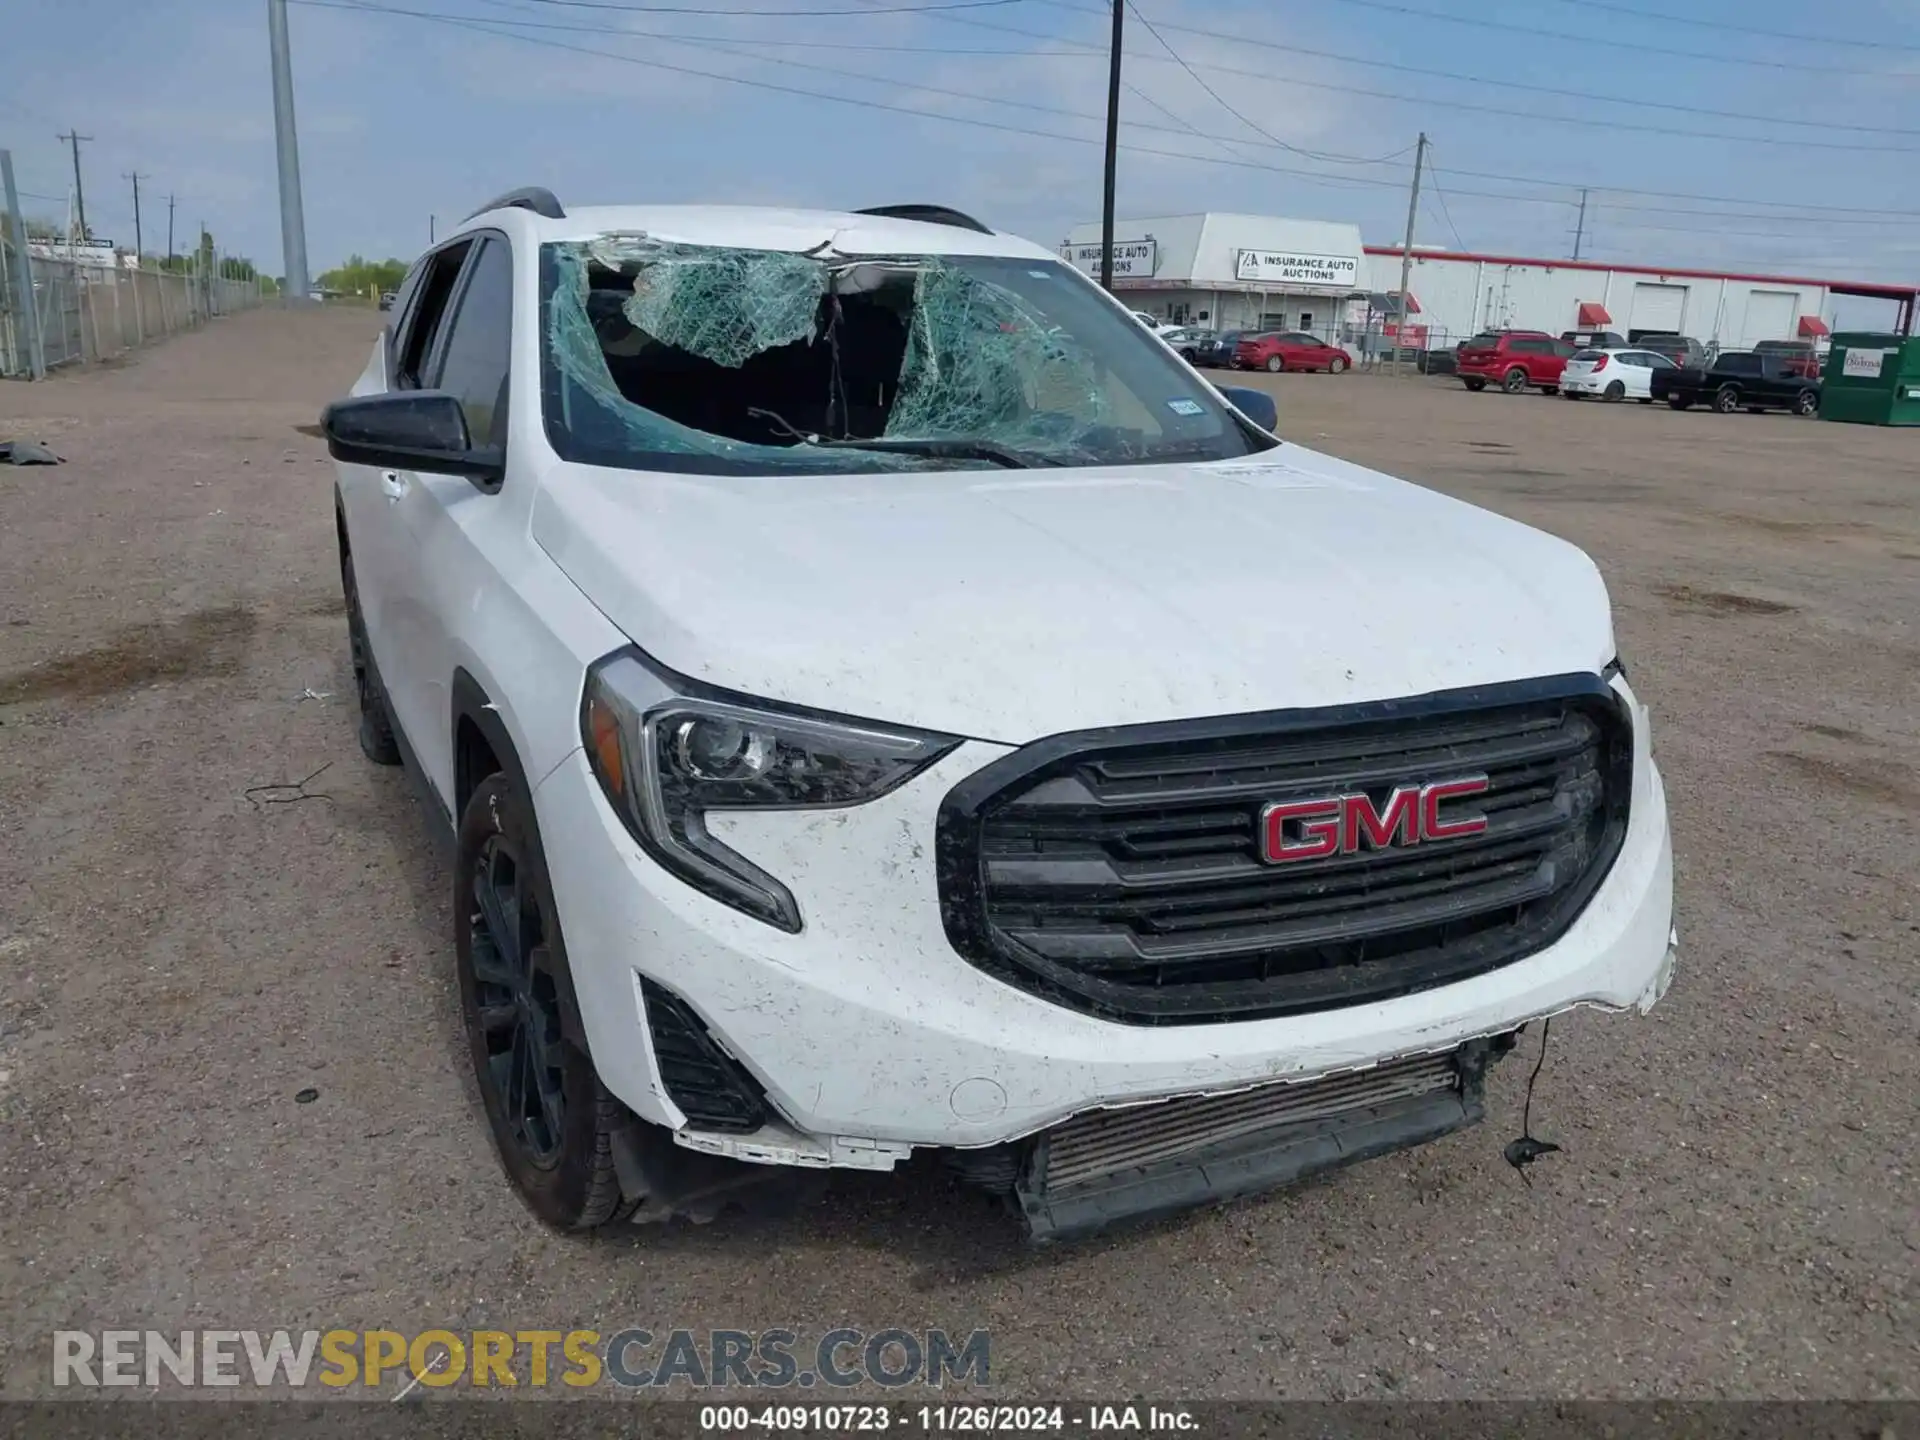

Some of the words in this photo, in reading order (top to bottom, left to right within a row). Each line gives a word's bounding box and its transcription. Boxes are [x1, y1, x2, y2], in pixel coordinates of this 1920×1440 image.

[1079, 247, 1123, 259] INSURCE
[1126, 246, 1148, 259] AUTO
[1264, 255, 1325, 269] INSURANCE
[1327, 260, 1354, 271] AUTO
[1282, 268, 1335, 280] AUCTIONS
[1259, 772, 1489, 865] GMC
